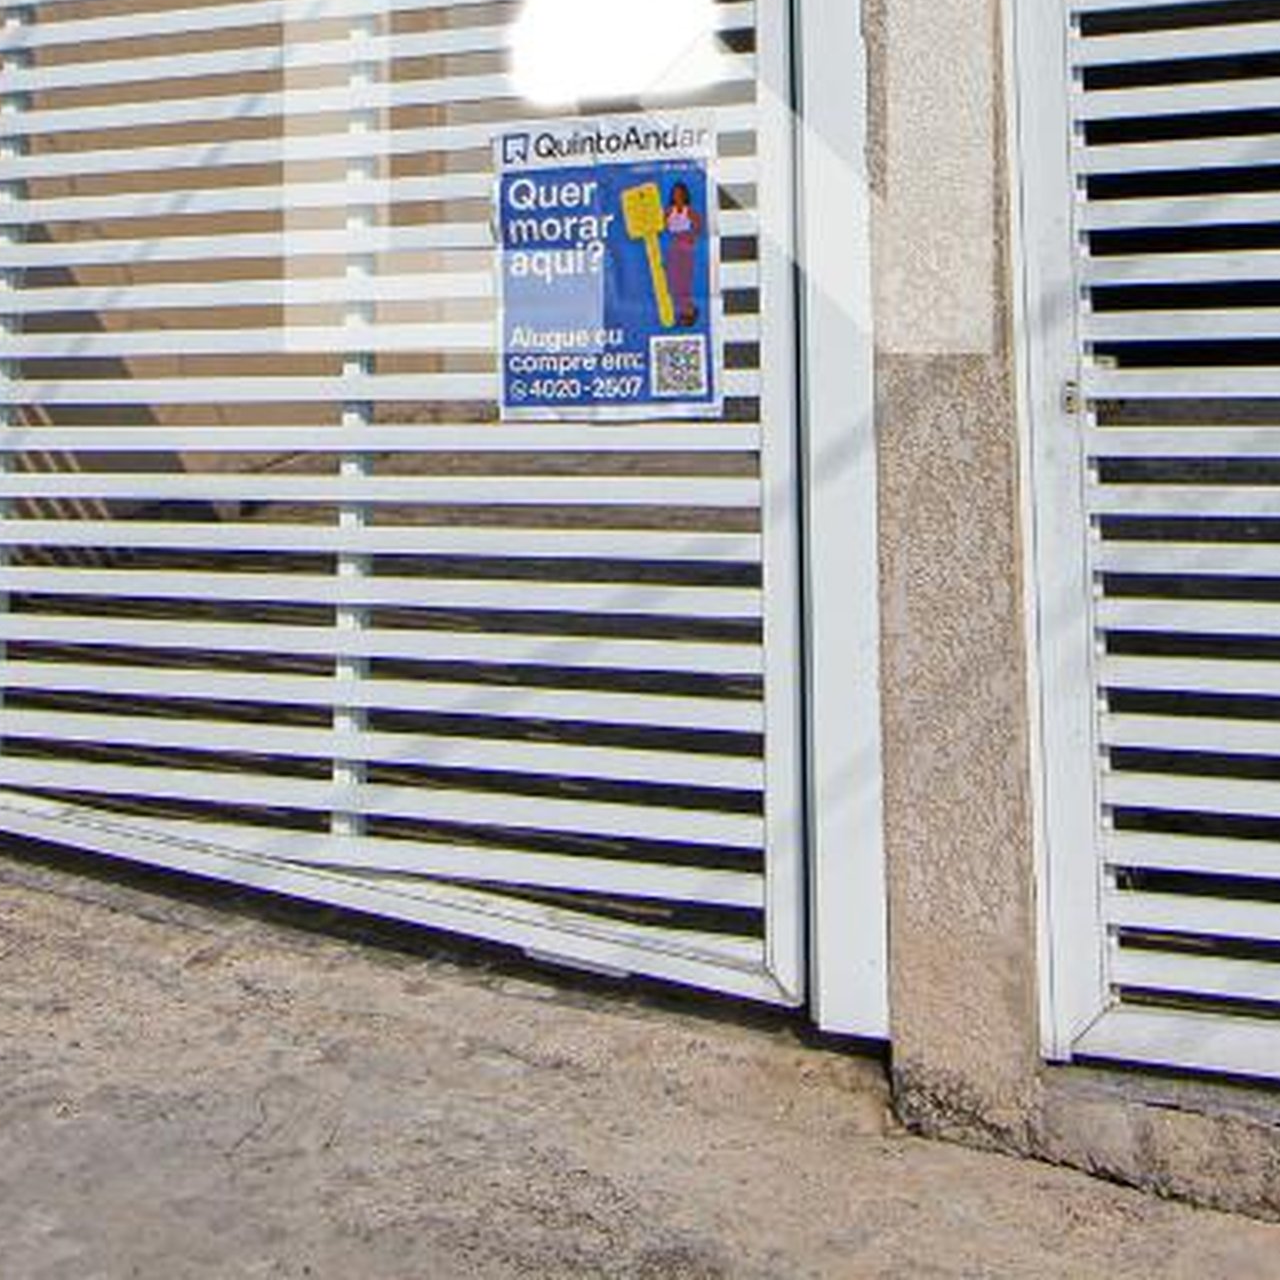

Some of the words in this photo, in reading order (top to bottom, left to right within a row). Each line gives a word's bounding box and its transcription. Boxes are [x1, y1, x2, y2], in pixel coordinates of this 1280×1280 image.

[534, 125, 706, 158] QuintoAndar
[508, 178, 597, 210] Quer
[510, 214, 613, 243] morar
[510, 241, 604, 283] aqui?
[509, 325, 590, 352] Alugue
[508, 354, 596, 376] compre
